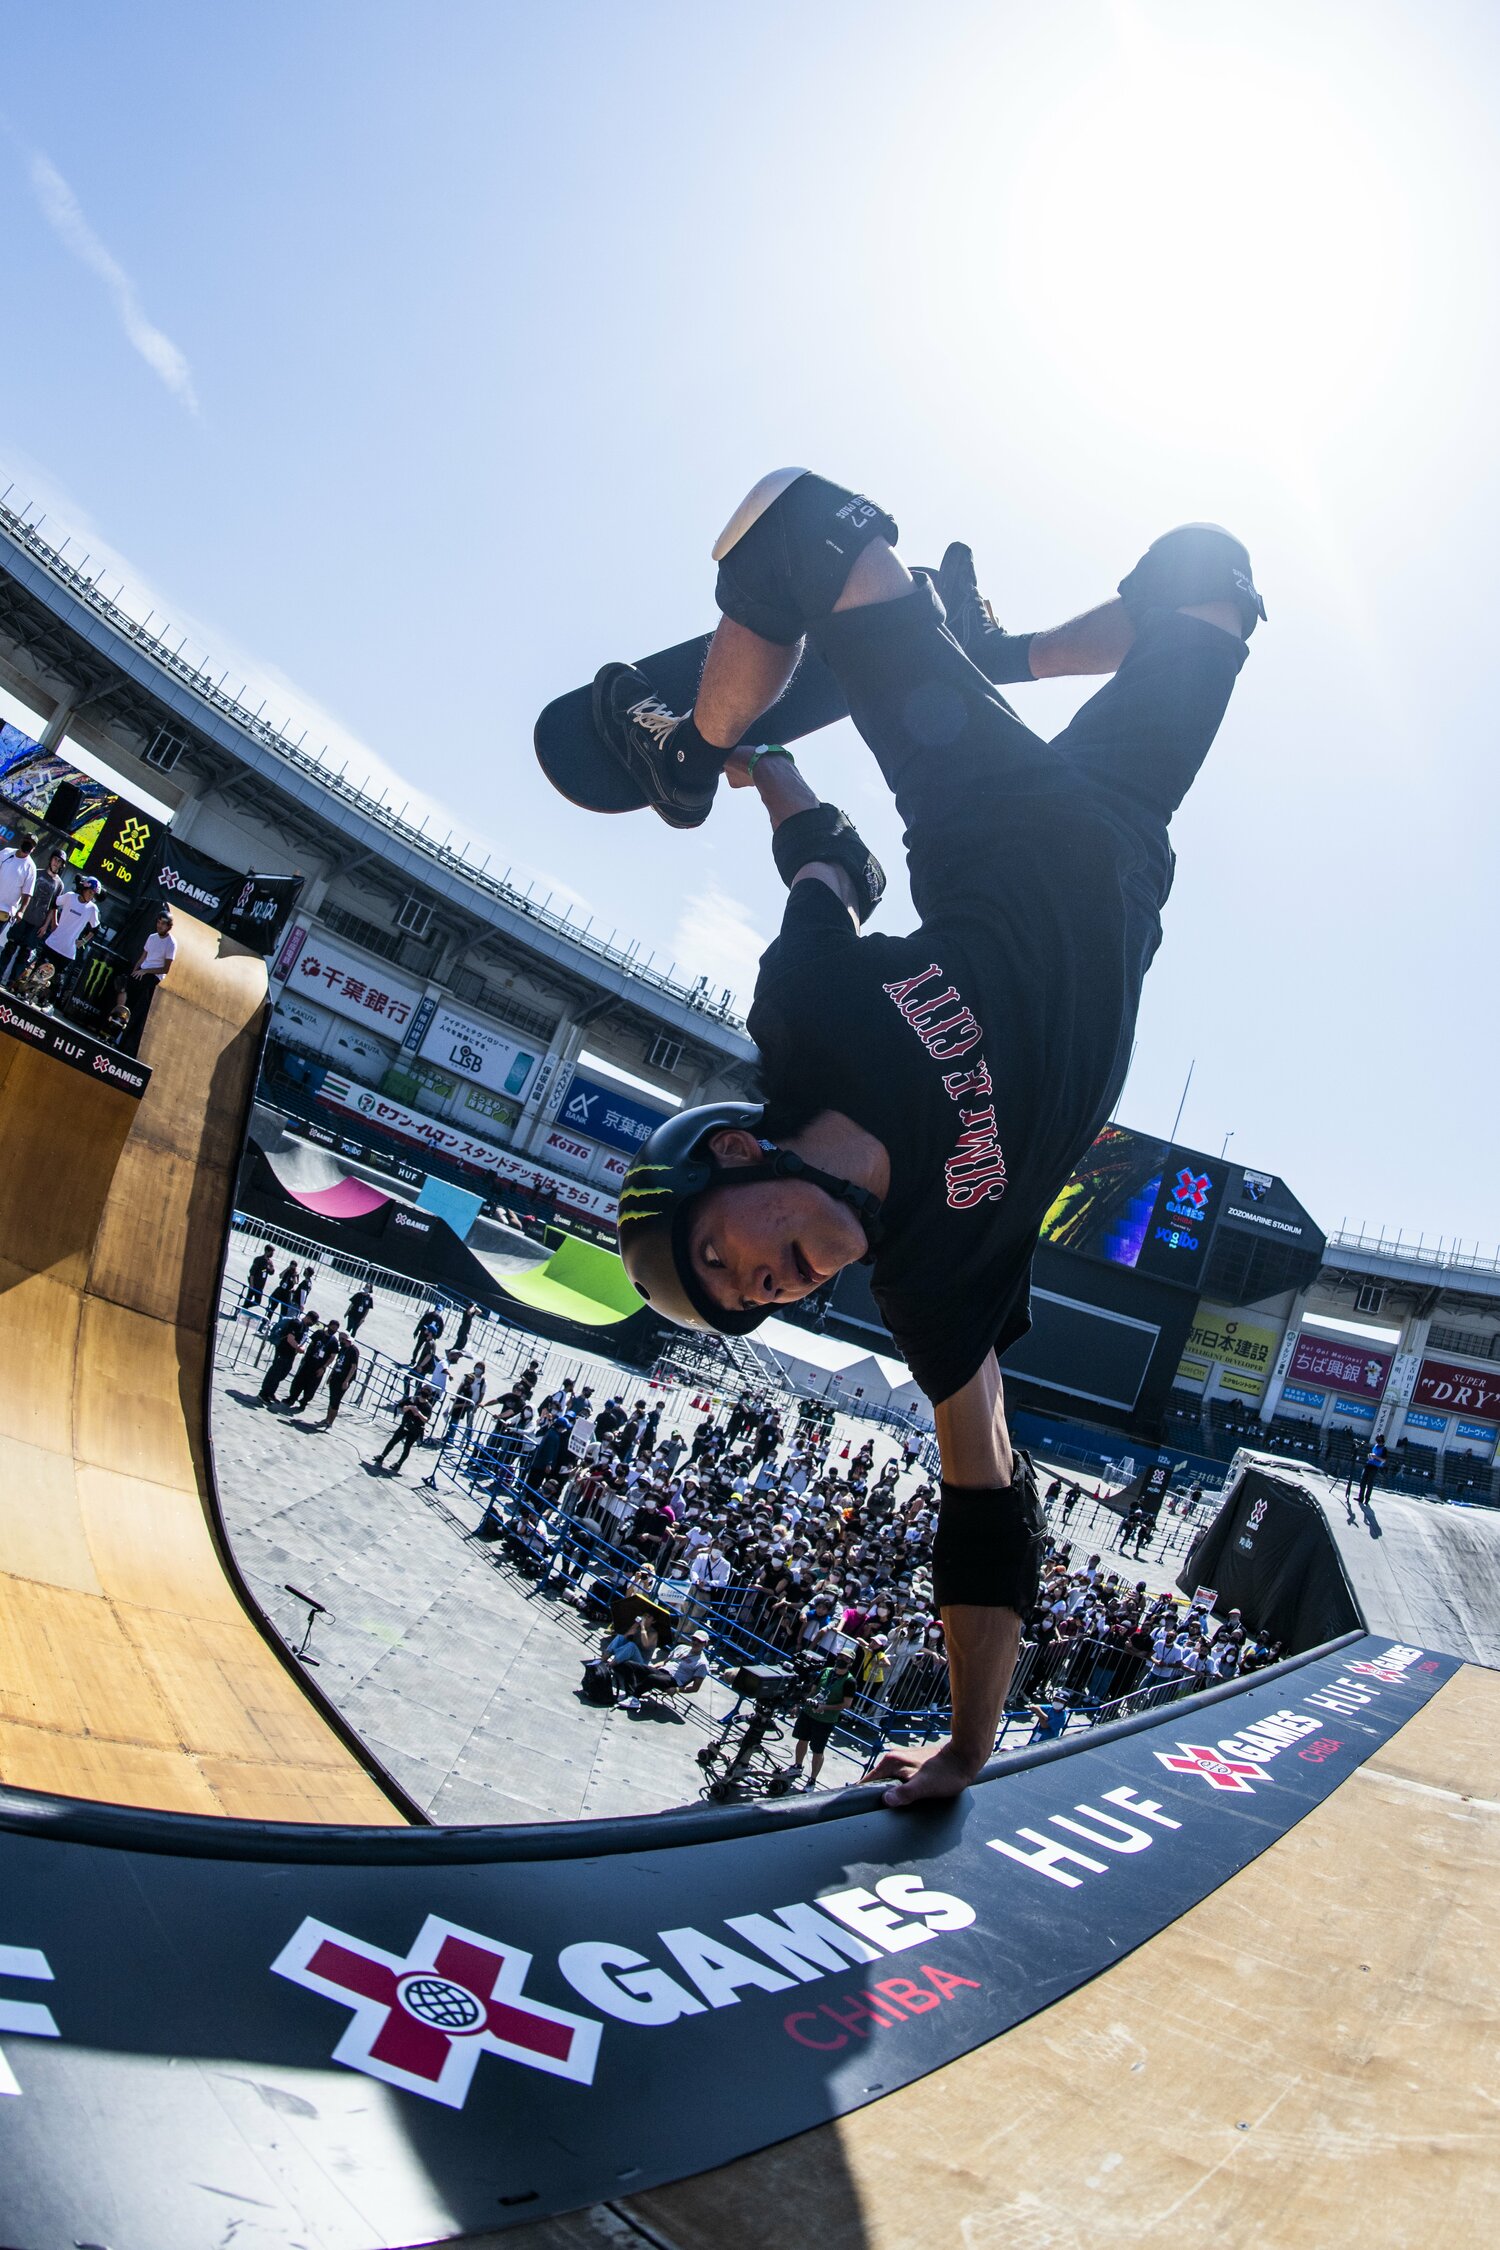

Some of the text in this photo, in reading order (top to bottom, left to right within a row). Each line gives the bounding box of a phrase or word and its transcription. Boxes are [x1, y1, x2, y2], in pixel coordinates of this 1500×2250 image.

[113, 841, 141, 861] GAMES
[176, 879, 221, 909] GAMES
[321, 965, 412, 1025] 千葉銀行
[290, 1005, 318, 1025] KAKUTA
[882, 963, 984, 1060] CITY
[443, 1015, 510, 1052] アイデアとテクノロジーで
[11, 1015, 47, 1040] GAMES
[53, 1037, 86, 1060] HUF
[107, 1064, 144, 1087] GAMES
[353, 1038, 381, 1056] KAKUTA
[565, 1110, 589, 1125] BANK
[602, 1109, 656, 1141] 京葉銀
[397, 1168, 418, 1181] HUF
[1165, 1201, 1206, 1222] GAMES
[1172, 1214, 1193, 1226] CHIBA
[1227, 1206, 1303, 1236] ZOZOMARINE STADIUM
[405, 1218, 430, 1232] GAMES
[1154, 1226, 1199, 1251] yogibo
[1187, 1327, 1269, 1363] 新日本建設
[1331, 1350, 1363, 1363] Marines!
[1184, 1345, 1222, 1362] NTELLIGENT
[1224, 1356, 1264, 1372] DEVELOPER
[1296, 1352, 1361, 1383] ちば興銀
[1452, 1373, 1488, 1388] SUPER
[1187, 1469, 1225, 1486] 三井住友
[1417, 1660, 1441, 1674] CHIBA
[1297, 1737, 1345, 1764] CHIBA
[558, 1874, 977, 2026] GAMES
[986, 1785, 1183, 1889] HUF
[1217, 1709, 1324, 1763] GAMES
[1303, 1677, 1382, 1716] HUF
[1371, 1644, 1425, 1672] GAMES
[783, 1964, 983, 2051] CHIBA
